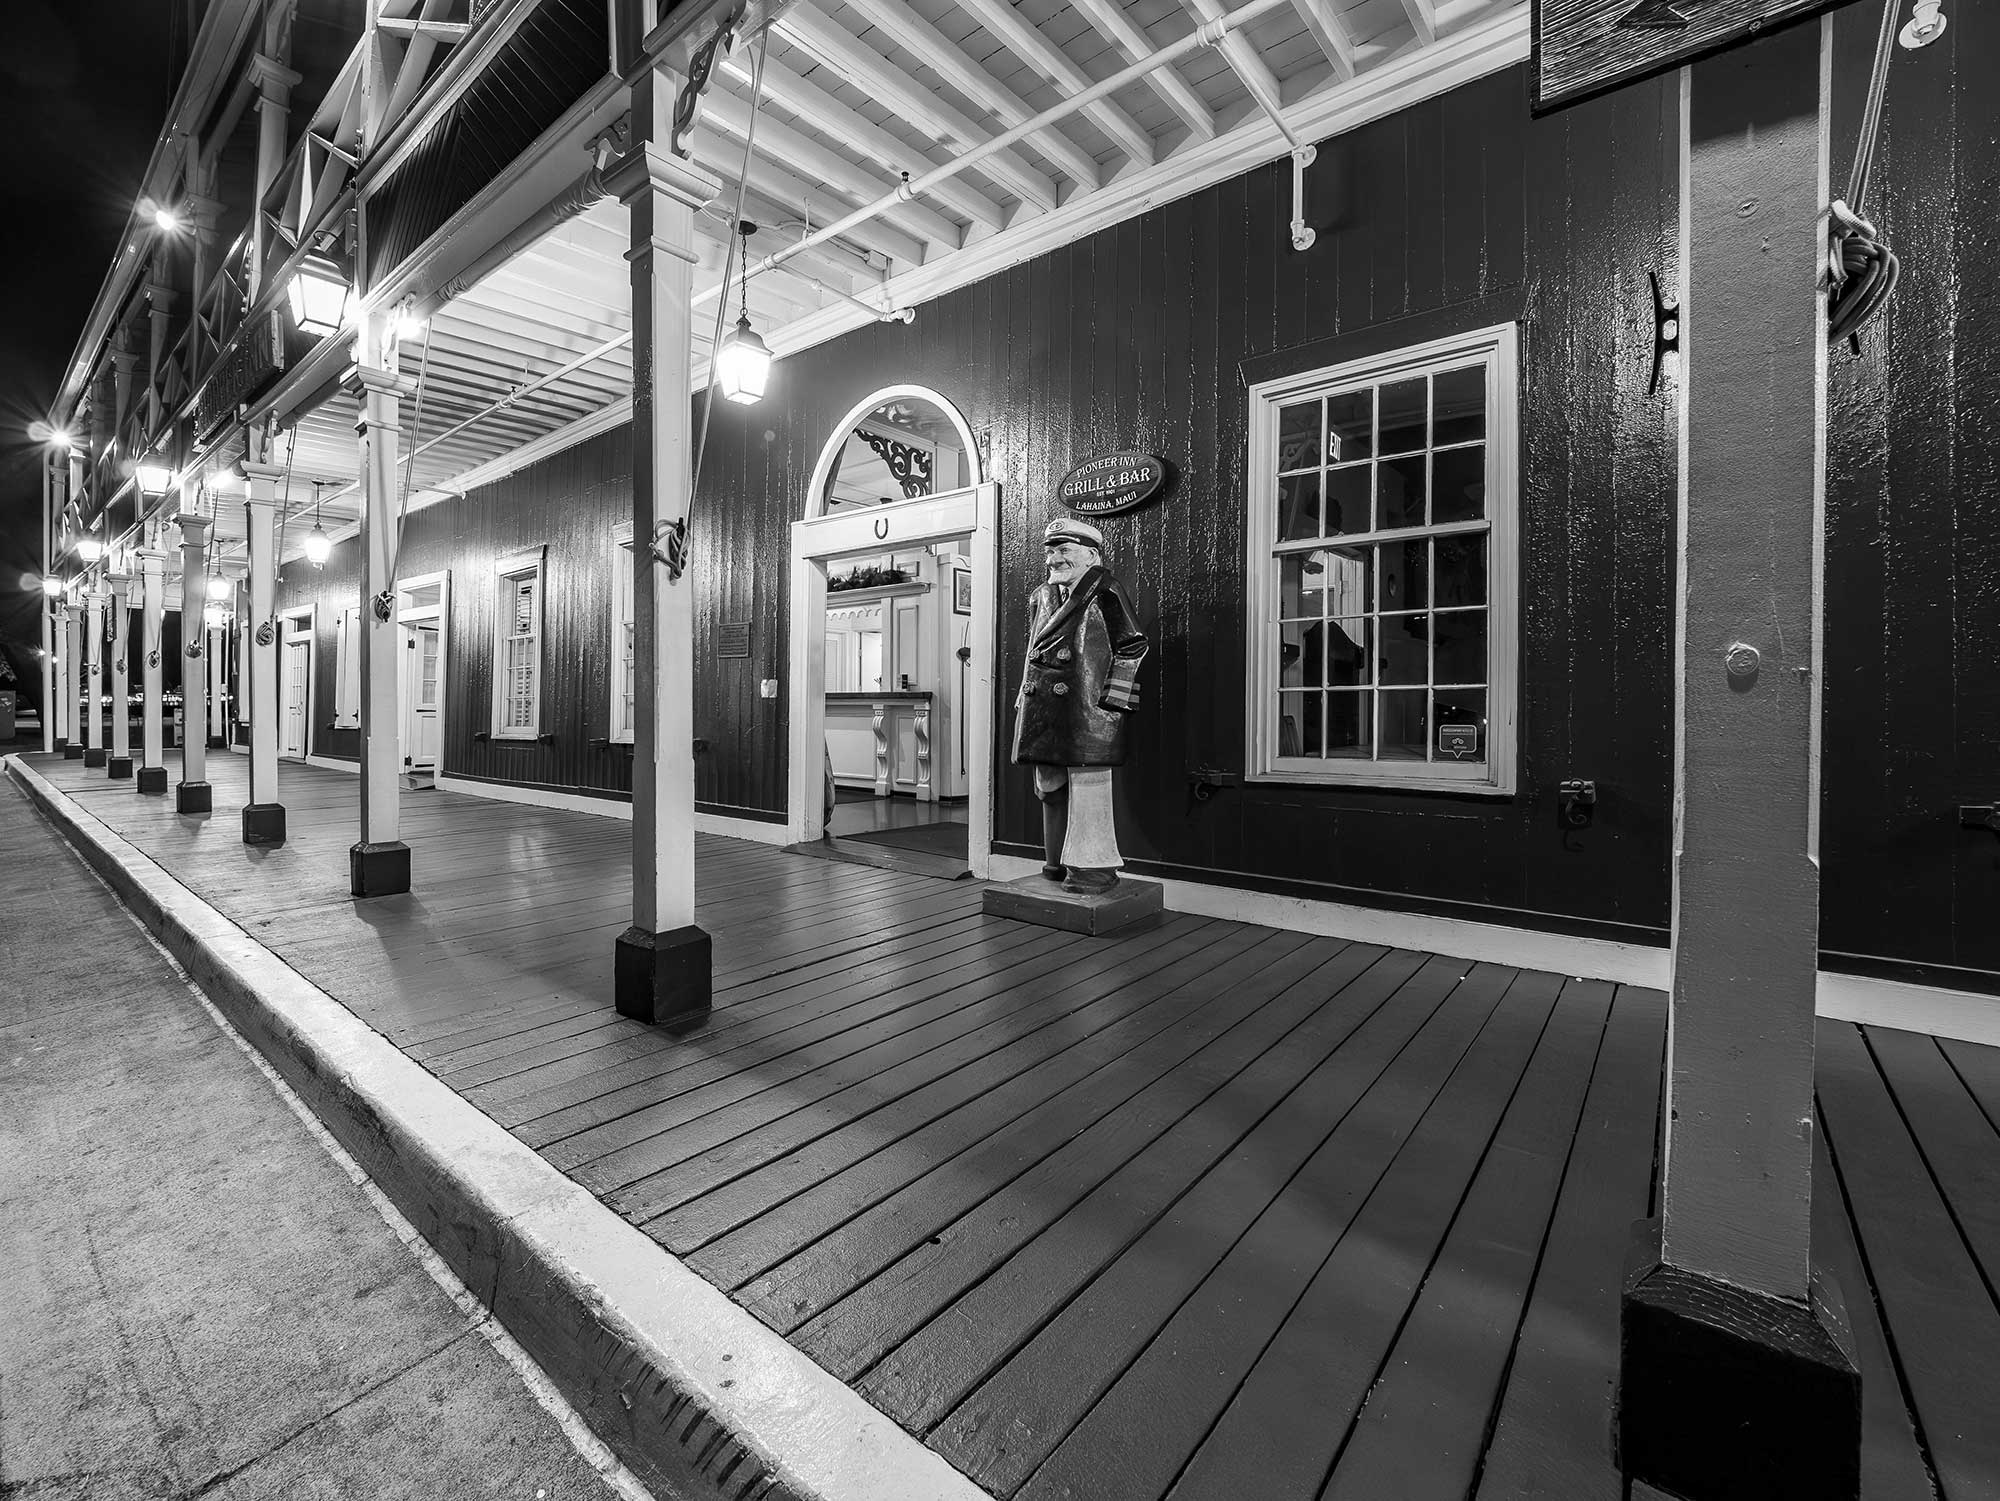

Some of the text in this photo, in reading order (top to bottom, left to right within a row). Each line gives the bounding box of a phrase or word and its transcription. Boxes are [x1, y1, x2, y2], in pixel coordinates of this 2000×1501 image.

[1076, 456, 1138, 479] PIONEER INN
[1064, 467, 1151, 496] GRILL & BAR
[1075, 490, 1137, 511] LAHAINA, MAUI
